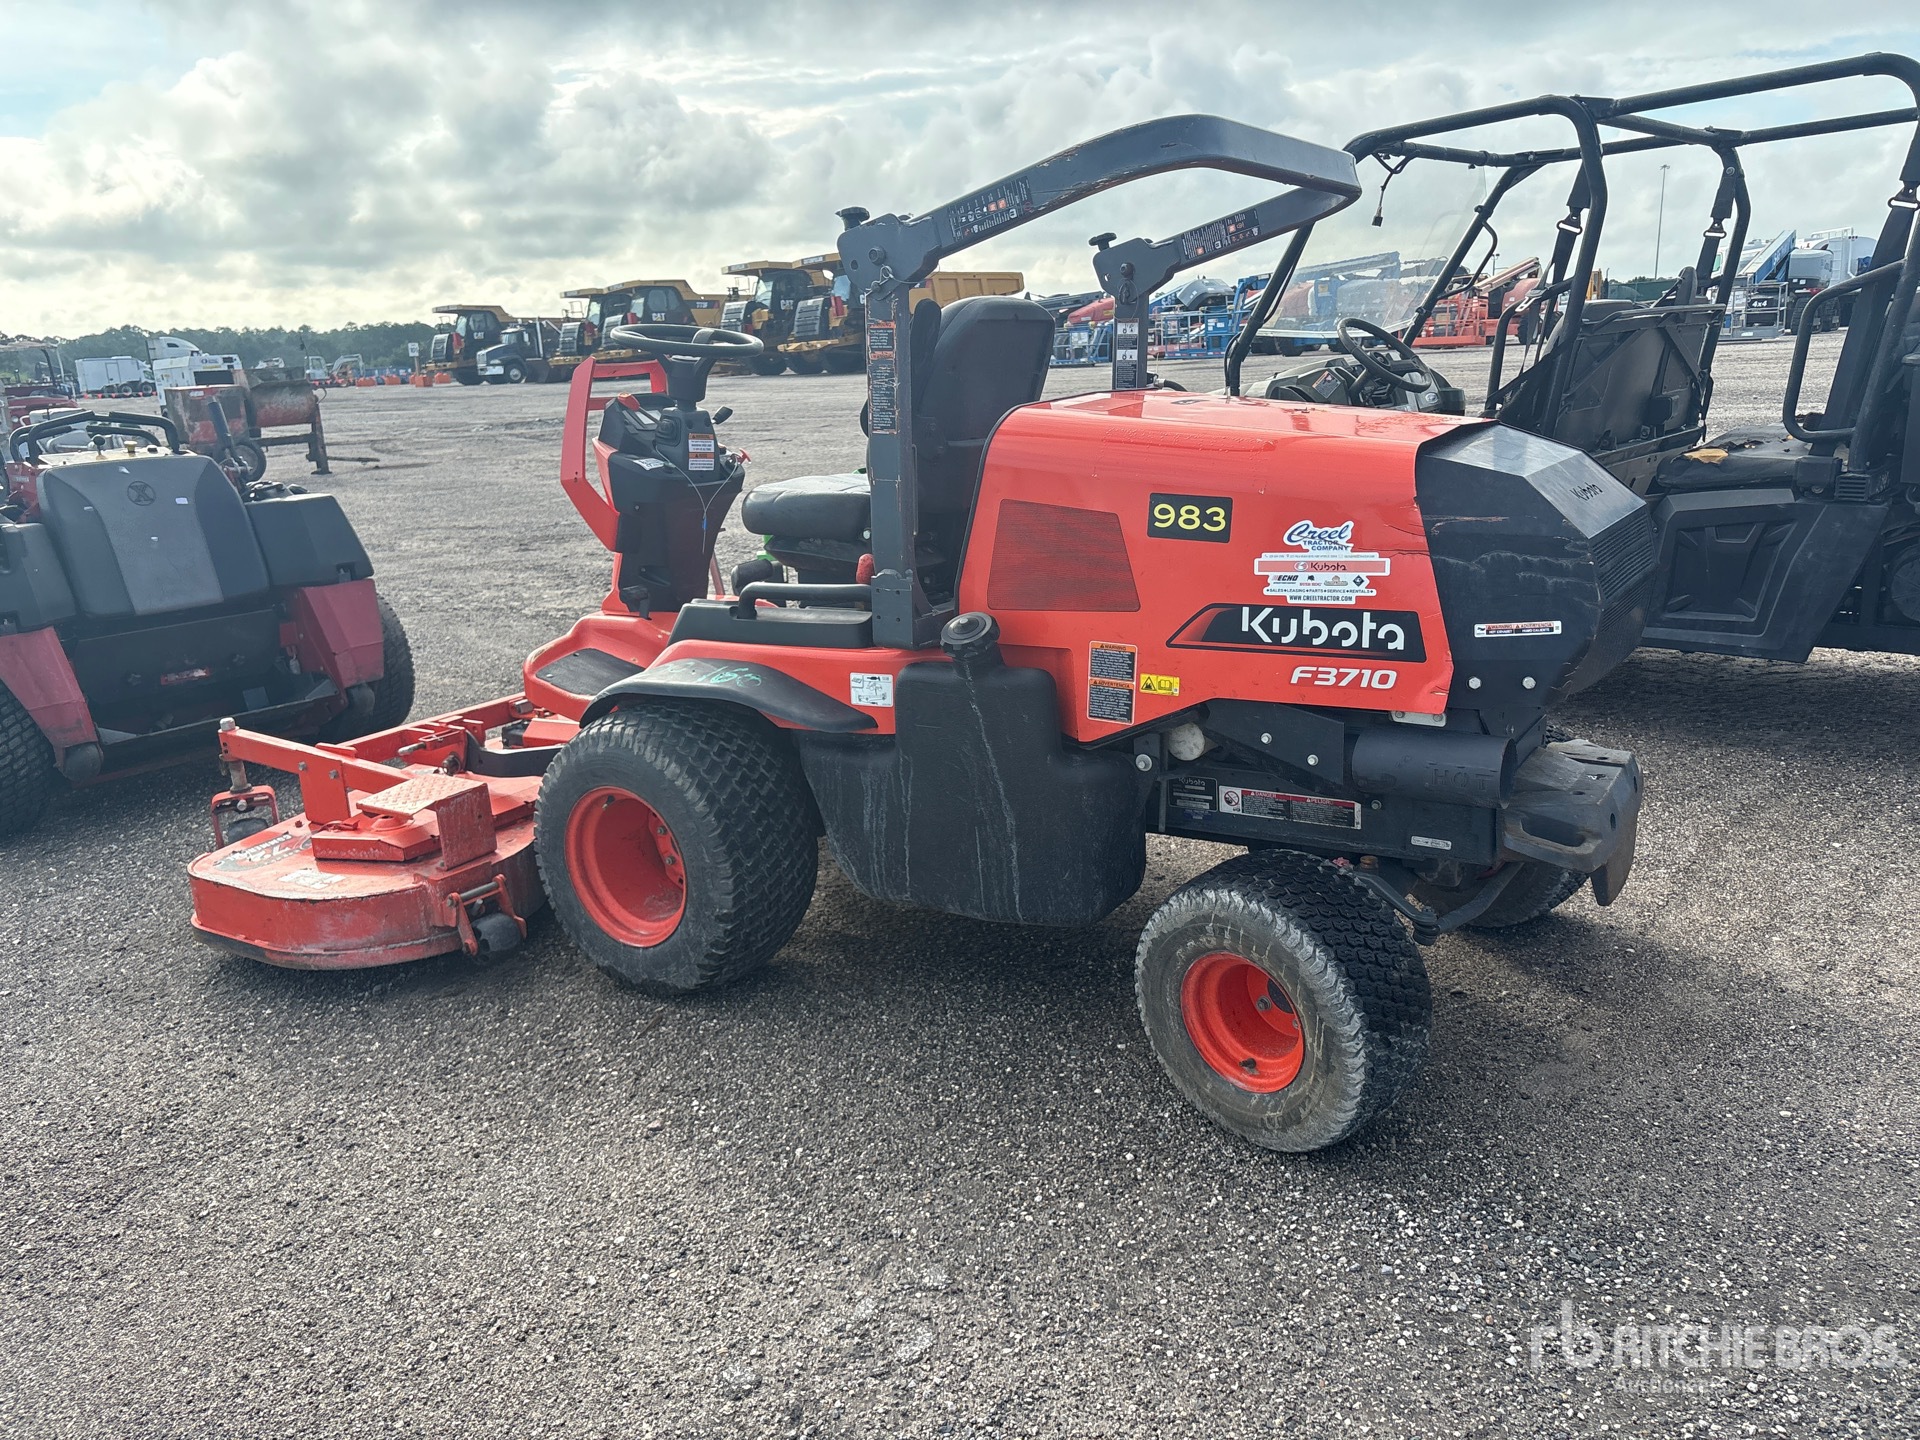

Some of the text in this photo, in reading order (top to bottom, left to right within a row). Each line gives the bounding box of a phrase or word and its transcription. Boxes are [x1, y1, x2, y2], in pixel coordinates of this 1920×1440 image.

[780, 299, 794, 310] CAT
[652, 312, 666, 321] CAT
[473, 332, 485, 340] CAT
[1569, 482, 1603, 501] Kubota
[1153, 503, 1226, 532] 983
[1287, 523, 1350, 543] Creel
[1310, 562, 1347, 571] Kubota
[1240, 606, 1405, 650] Kubota
[1290, 666, 1398, 689] F3710
[1178, 777, 1206, 786] Kubota
[1432, 768, 1494, 791] HOT
